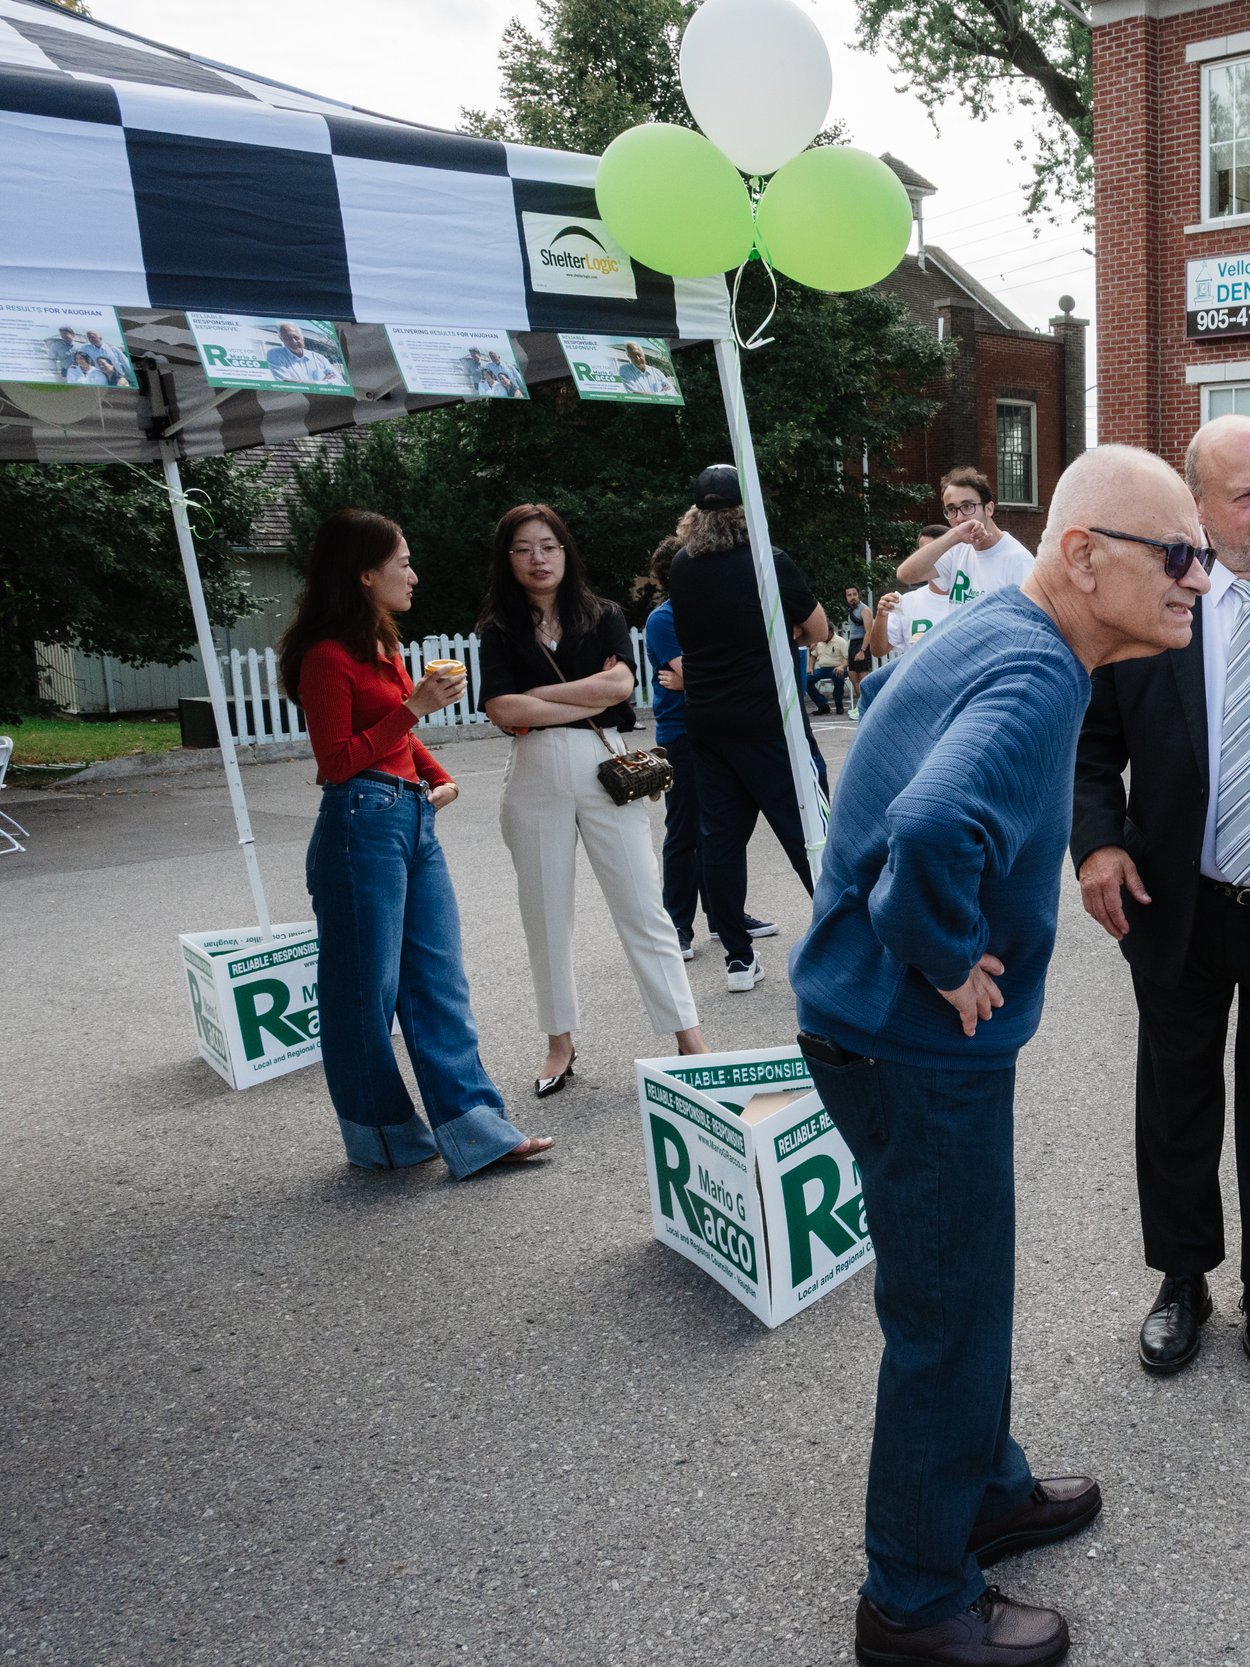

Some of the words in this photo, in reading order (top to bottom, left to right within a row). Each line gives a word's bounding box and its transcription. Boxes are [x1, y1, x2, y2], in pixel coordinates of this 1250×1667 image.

[540, 248, 619, 274] ShelterLogic
[5, 304, 42, 313] RESULTS
[62, 308, 102, 316] VAUGHAN
[393, 327, 429, 335] DELIVERING
[232, 955, 270, 976] RELIABLE
[253, 1058, 272, 1071] Local
[274, 1054, 286, 1064] and
[287, 1043, 315, 1060] Regional
[646, 1082, 674, 1109] RELIABLE
[675, 1095, 712, 1131] RESPONSIBLE
[711, 1117, 745, 1153] RESPONSIVE
[777, 1119, 818, 1157] RELIABLE
[649, 1112, 753, 1273] Racco
[698, 1164, 734, 1212] Mario
[736, 1192, 746, 1222] G
[665, 1222, 680, 1239] Local
[680, 1233, 690, 1245] and
[689, 1238, 711, 1261] Regional
[798, 1279, 819, 1302] Local
[821, 1268, 834, 1286] and
[835, 1246, 865, 1275] Regional
